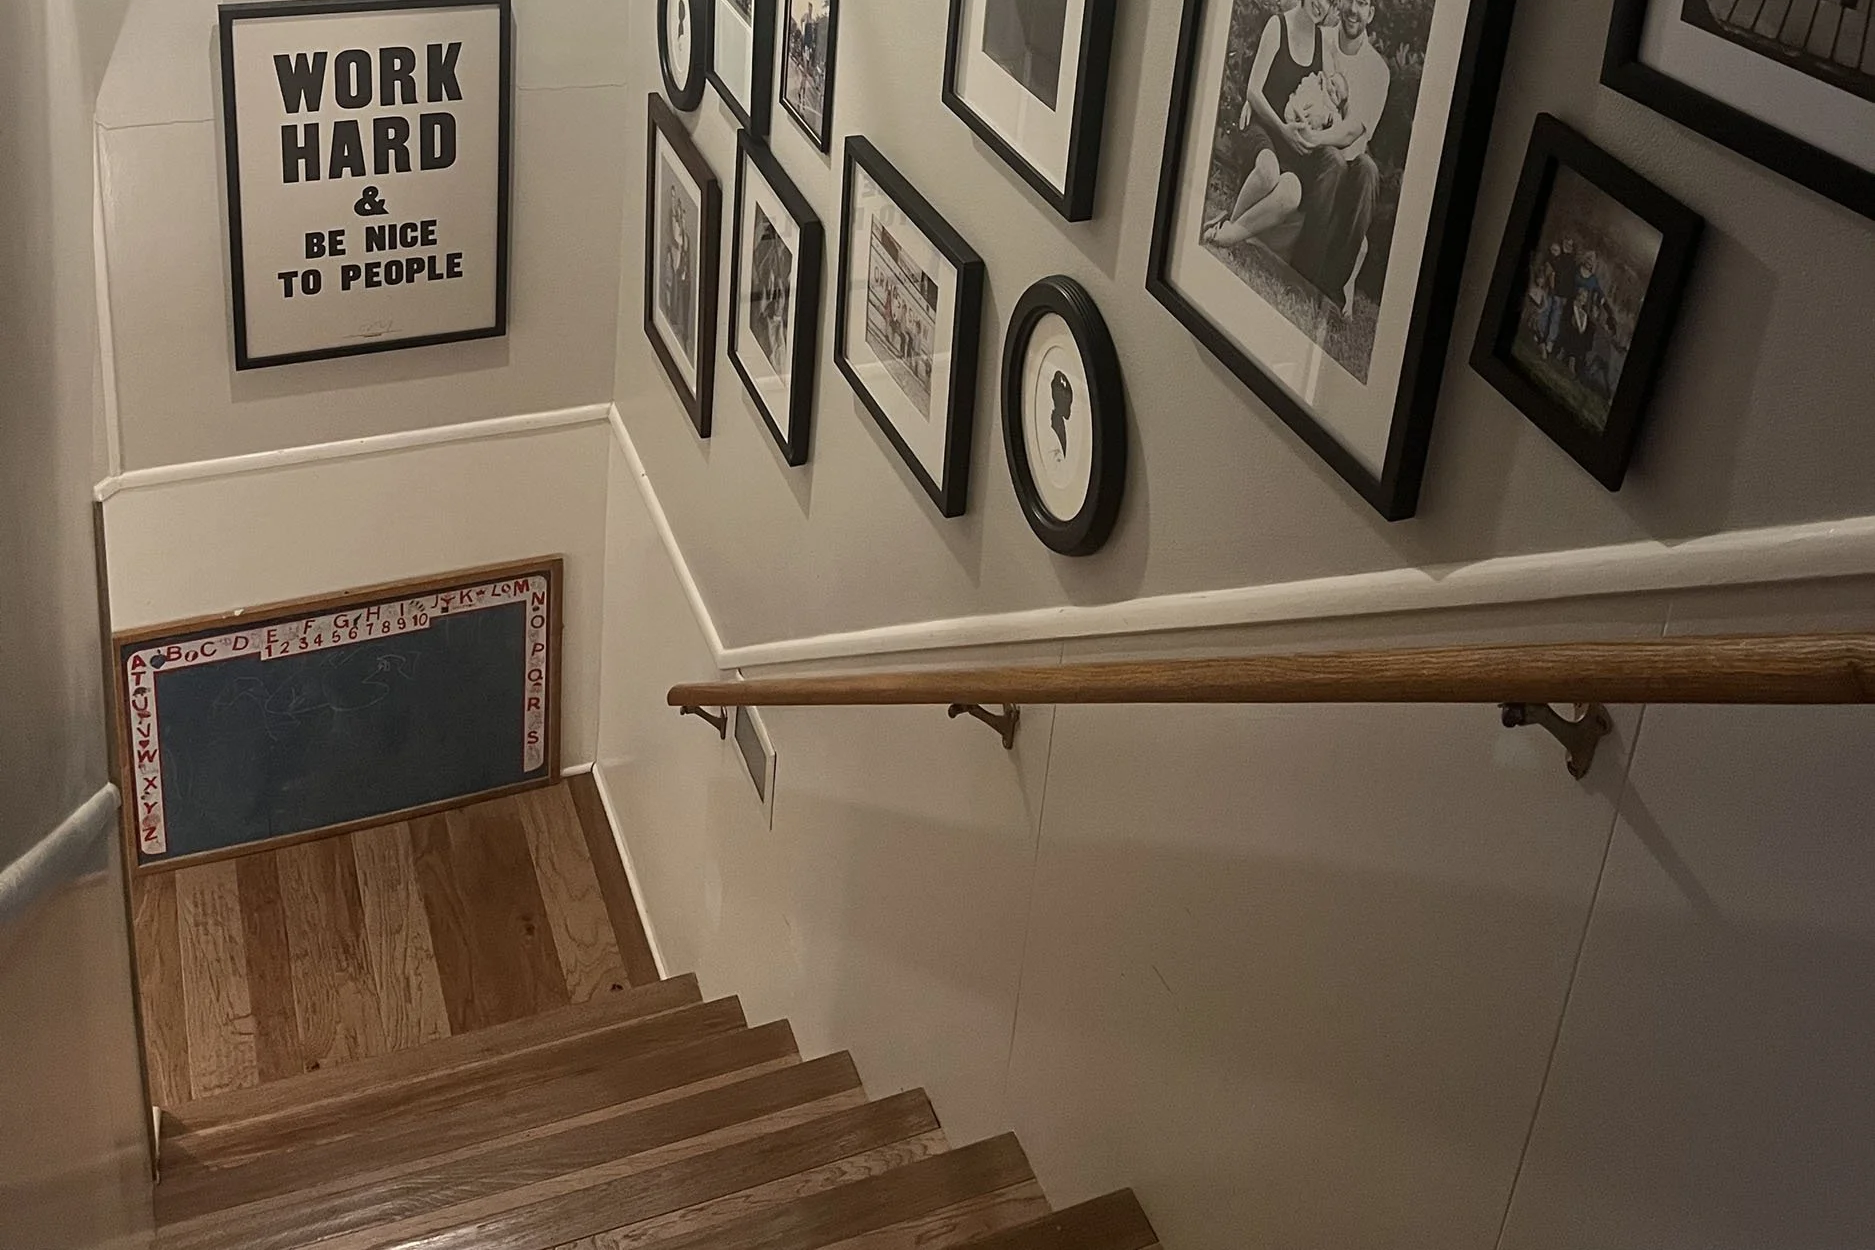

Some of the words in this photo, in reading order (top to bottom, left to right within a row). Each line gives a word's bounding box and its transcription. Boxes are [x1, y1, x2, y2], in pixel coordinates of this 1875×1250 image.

[273, 42, 463, 113] WORK
[281, 112, 456, 183] HARD
[354, 186, 389, 216] &
[305, 230, 346, 259] BE
[365, 219, 438, 252] NICE
[277, 268, 322, 298] TO
[341, 252, 464, 291] PEOPLE
[531, 591, 545, 606] N
[131, 655, 146, 671] A
[166, 646, 182, 662] B
[200, 641, 217, 657] C
[232, 636, 249, 650] D
[267, 629, 279, 643] E
[303, 619, 315, 634] F
[334, 614, 349, 628] G
[366, 607, 380, 622] H
[459, 590, 473, 604] K
[492, 584, 501, 596] L
[514, 579, 530, 594] M
[531, 615, 545, 628] O
[264, 644, 273, 657] 1
[280, 642, 290, 654] 2
[298, 637, 309, 649] 3
[314, 634, 324, 646] 4
[332, 630, 341, 643] 5
[348, 626, 358, 639] 6
[366, 623, 374, 635] 7
[382, 621, 391, 633] 8
[397, 618, 406, 629] 9
[413, 613, 428, 626] 10
[531, 643, 544, 657] P
[131, 672, 146, 686] T
[528, 669, 543, 682] Q
[132, 696, 148, 710] U
[527, 697, 541, 711] R
[137, 723, 150, 738] V
[528, 731, 539, 744] S
[138, 750, 157, 762] W
[144, 777, 157, 790] X
[144, 802, 158, 814] Y
[143, 827, 157, 842] Z
